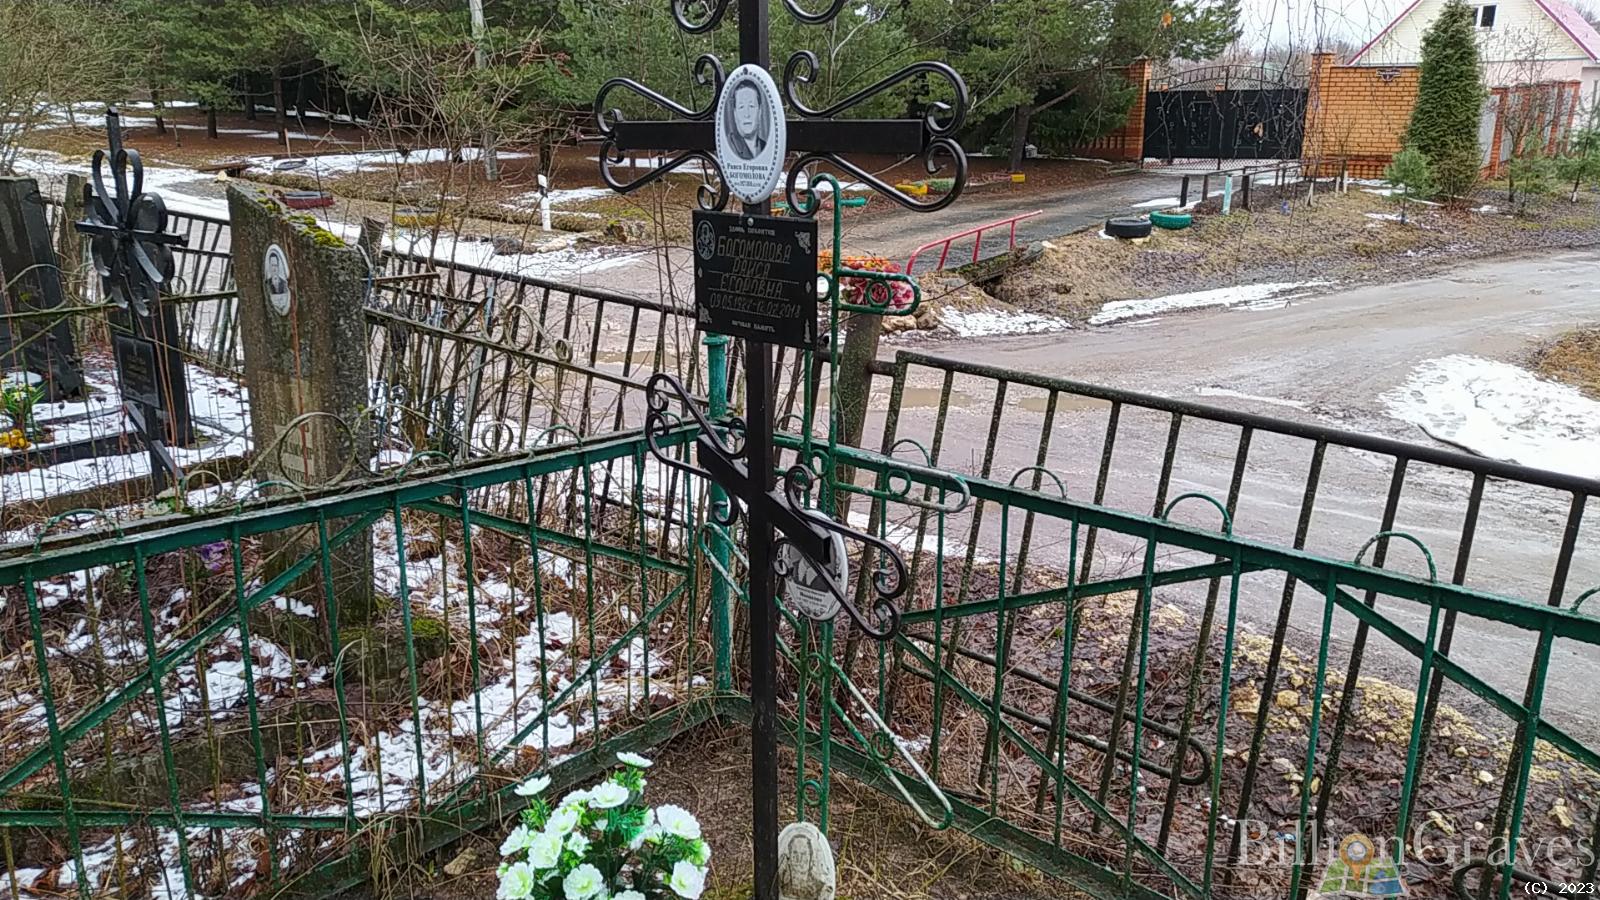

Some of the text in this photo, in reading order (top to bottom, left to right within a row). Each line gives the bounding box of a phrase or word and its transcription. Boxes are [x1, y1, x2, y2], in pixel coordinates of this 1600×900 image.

[717, 235, 792, 263] БОГОМОЛОВА
[732, 257, 771, 279] РАИСА
[720, 274, 783, 299] ЕГОРОВНА
